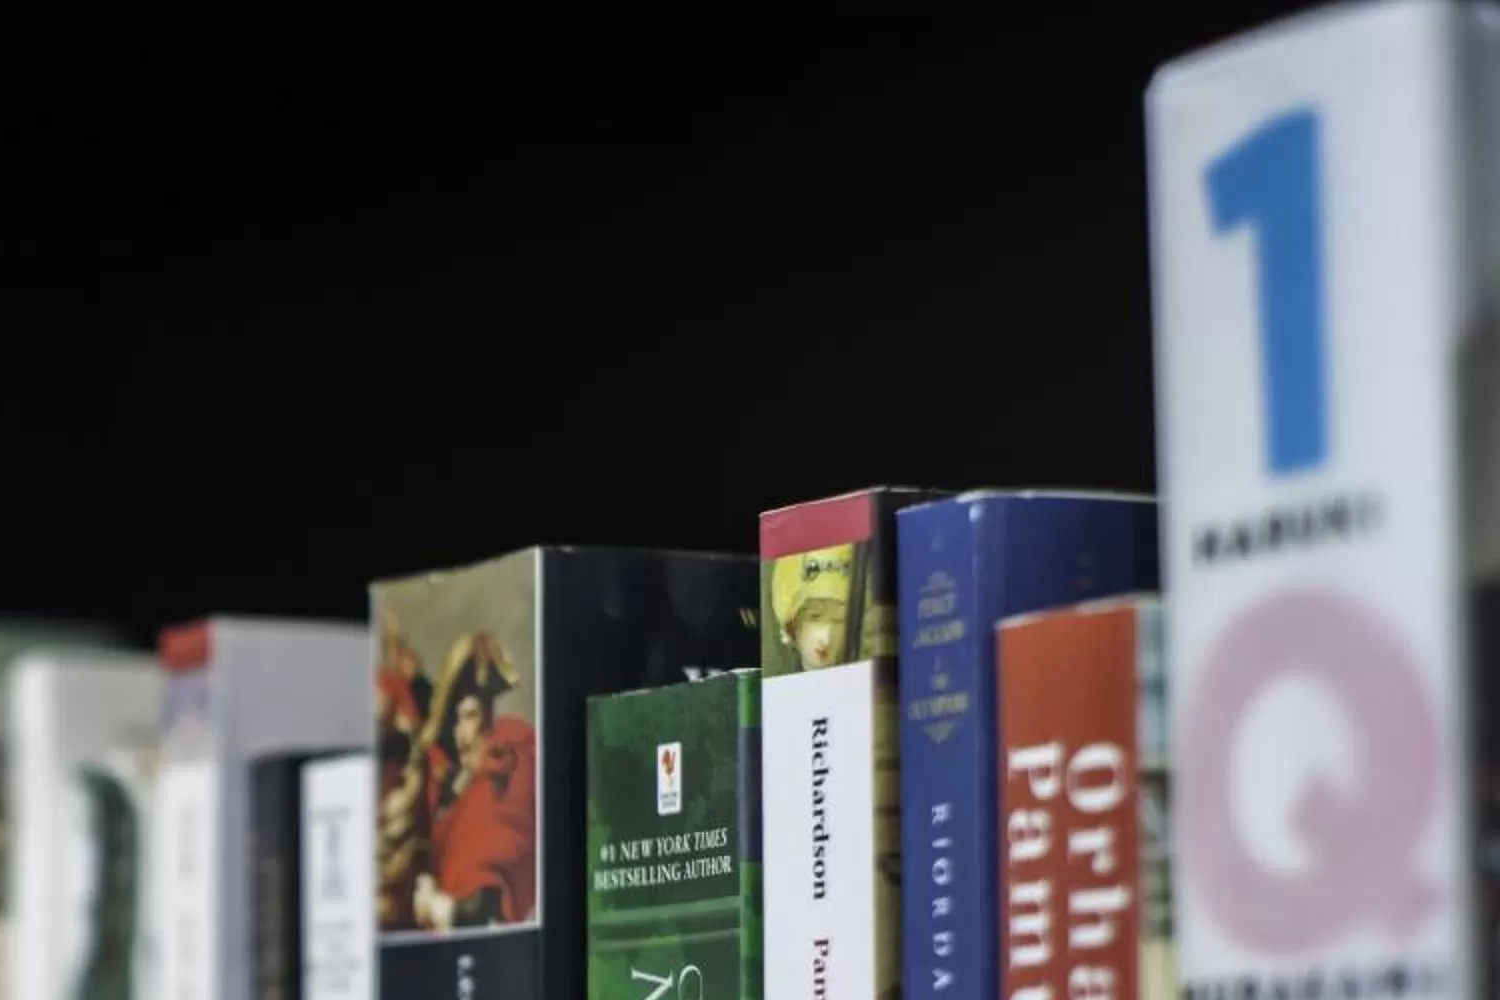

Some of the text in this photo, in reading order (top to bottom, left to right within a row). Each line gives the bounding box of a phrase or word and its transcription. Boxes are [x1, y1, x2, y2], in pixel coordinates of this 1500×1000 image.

[1201, 106, 1330, 478] 1
[620, 837, 653, 861] NEW
[656, 832, 691, 857] YORK
[694, 827, 729, 850] TIMES
[810, 717, 831, 900] Richardson
[1183, 582, 1440, 955] Q
[593, 855, 732, 891] BESTSELLING AUTHOR
